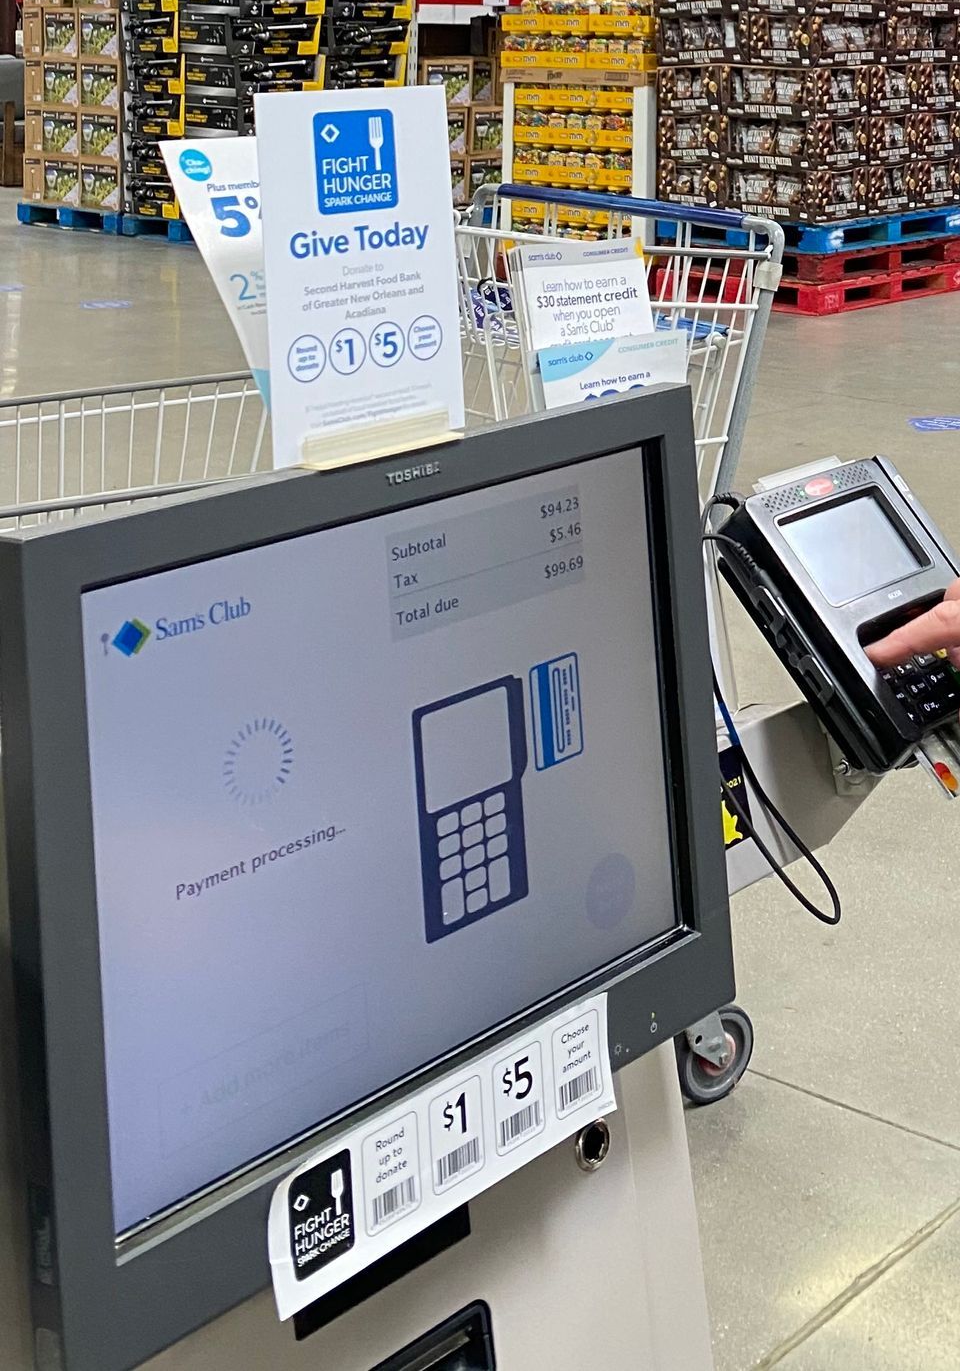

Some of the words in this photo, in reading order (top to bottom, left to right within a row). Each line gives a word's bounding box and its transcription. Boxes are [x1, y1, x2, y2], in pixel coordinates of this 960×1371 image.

[322, 155, 369, 175] FIGHT
[206, 183, 227, 193] Plus
[227, 179, 260, 191] memb
[323, 173, 392, 195] HUNGER
[324, 195, 353, 208] SPARK
[353, 191, 393, 205] CHANGE
[290, 230, 349, 259] Give
[353, 221, 429, 251] Today
[582, 249, 610, 257] CONSUMER
[610, 247, 629, 255] CREDIT
[342, 265, 374, 276] Donate
[375, 263, 384, 271] to
[303, 283, 338, 296] Second
[339, 278, 374, 291] Harvest
[376, 274, 398, 286] Food
[399, 271, 421, 282] Bank
[542, 280, 564, 293] Learn
[564, 278, 583, 291] how
[584, 278, 594, 289] to
[595, 276, 618, 288] earn
[619, 276, 627, 286] a
[302, 301, 312, 312] of
[313, 297, 348, 310] Greater
[350, 293, 371, 304] New
[372, 288, 407, 301] Orleans
[407, 285, 424, 295] and
[536, 295, 555, 309] $30
[556, 292, 603, 307] statement
[604, 287, 639, 302] credit
[345, 307, 386, 320] Acadiana
[552, 309, 575, 322] when
[575, 310, 593, 323] you
[593, 306, 621, 320] open
[560, 327, 566, 337] a
[566, 322, 589, 336] Sam's
[335, 338, 355, 366] $1
[374, 331, 398, 358] $5
[618, 341, 655, 354] CONSUMER
[655, 338, 679, 348] CREDIT
[547, 356, 568, 367] sam's
[568, 353, 584, 364] club
[579, 378, 600, 390] Learn
[601, 375, 618, 387] how
[618, 374, 627, 383] to
[627, 372, 645, 382] earn
[645, 370, 651, 378] a
[391, 533, 447, 562] Subtotal
[540, 496, 580, 519] $94.23
[393, 571, 419, 589] Tax
[549, 521, 582, 544] $5.46
[396, 602, 430, 626] Total
[434, 596, 459, 614] due
[543, 555, 584, 579] $99.69
[155, 614, 205, 641] Sam's
[208, 596, 251, 625] Club
[918, 656, 925, 664] 6
[910, 684, 918, 693] 8
[930, 675, 937, 683] 9
[726, 775, 742, 788] 021
[175, 860, 246, 901] Payment
[560, 1023, 590, 1044] Choose
[567, 1039, 585, 1058] your
[562, 1049, 592, 1074] amount
[502, 1055, 533, 1100] $5
[443, 1092, 467, 1134] $1
[375, 1127, 405, 1152] Round
[379, 1153, 391, 1167] up
[393, 1147, 403, 1158] to
[375, 1160, 408, 1184] donate
[294, 1207, 332, 1241] FIGHT
[295, 1213, 350, 1256] HUNGER
[297, 1247, 321, 1267] SPARK
[320, 1228, 351, 1253] CHANGE
